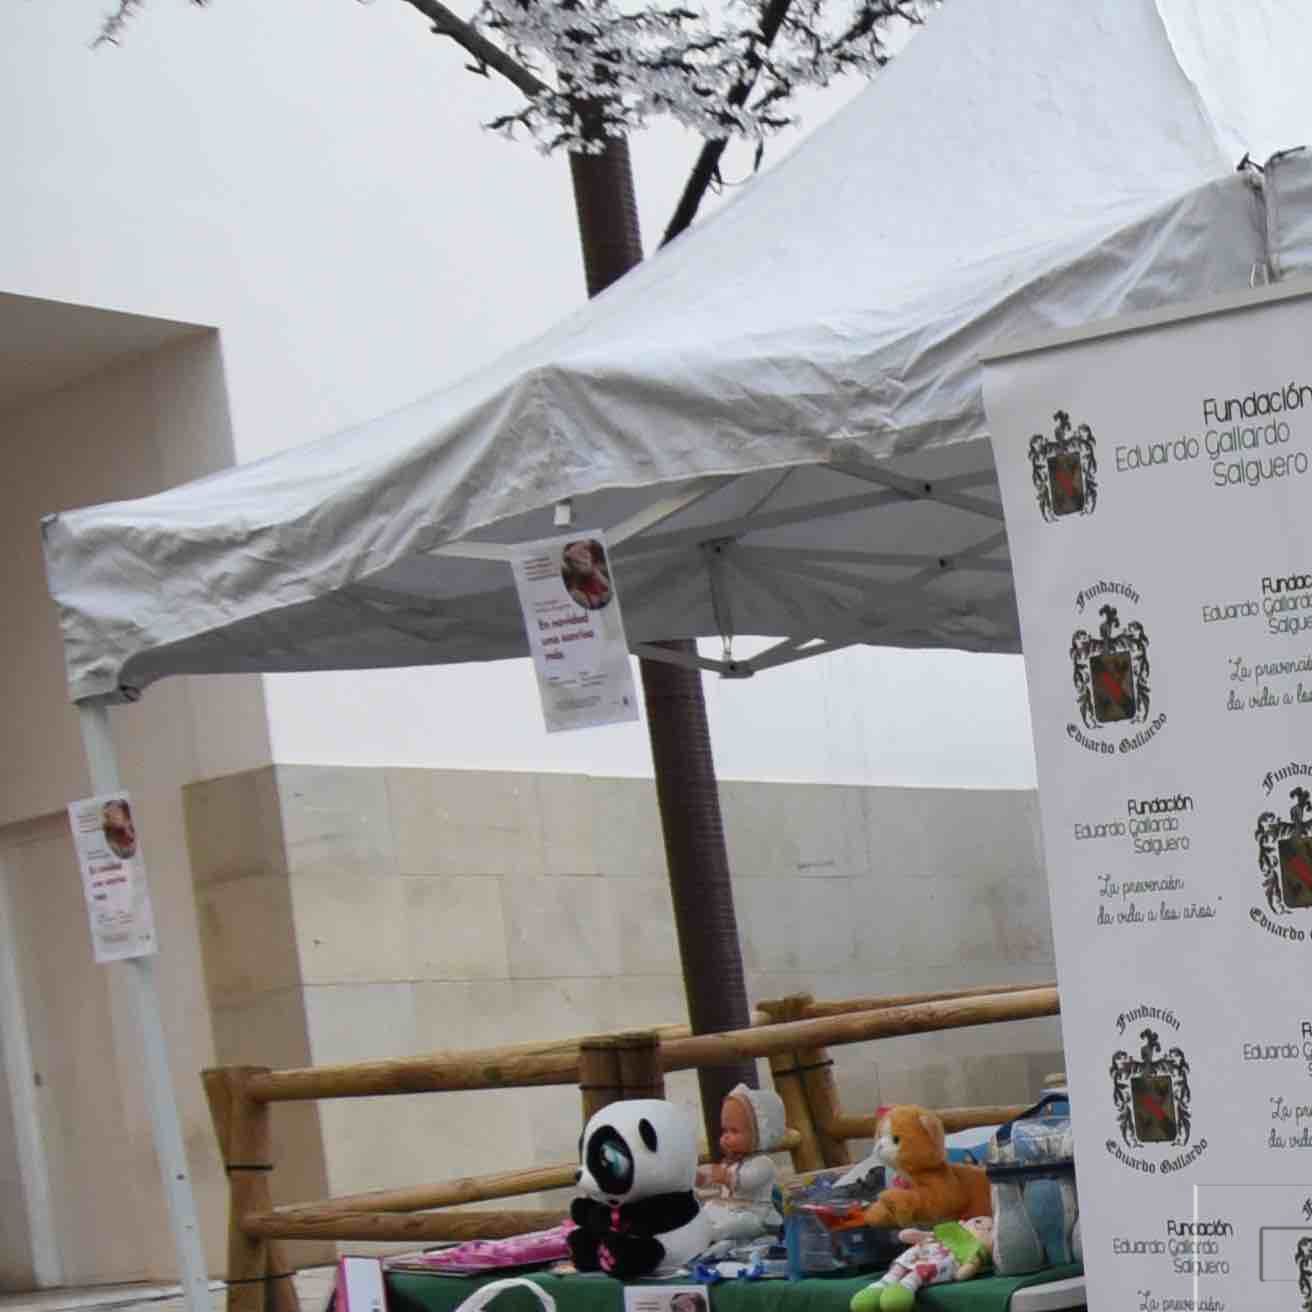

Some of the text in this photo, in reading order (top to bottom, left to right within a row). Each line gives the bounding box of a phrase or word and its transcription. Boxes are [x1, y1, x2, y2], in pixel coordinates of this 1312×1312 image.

[1116, 419, 1290, 472] Eduardo Gallardo
[1213, 450, 1307, 488] Salguero
[1076, 580, 1140, 614] Fundación
[1203, 601, 1259, 622] Eduardo
[1227, 690, 1244, 711] da
[1249, 687, 1279, 709] vida
[1283, 693, 1293, 705] a
[1067, 712, 1167, 754] Eduardo Gallardo
[1128, 794, 1193, 817] Fundación
[1074, 817, 1178, 840] Eduardo Gallardo
[1134, 836, 1189, 855] Salguero
[1123, 878, 1184, 895] prevención
[1097, 906, 1113, 925] da
[1117, 904, 1144, 924] vida
[1148, 911, 1157, 922] a
[1160, 901, 1181, 921] los
[1250, 907, 1304, 941] Eduardo
[1115, 1005, 1181, 1035] Fundación
[1244, 1044, 1299, 1060] Eduardo
[1268, 1128, 1284, 1148] da
[1105, 1138, 1208, 1174] Eduardo Gallardo
